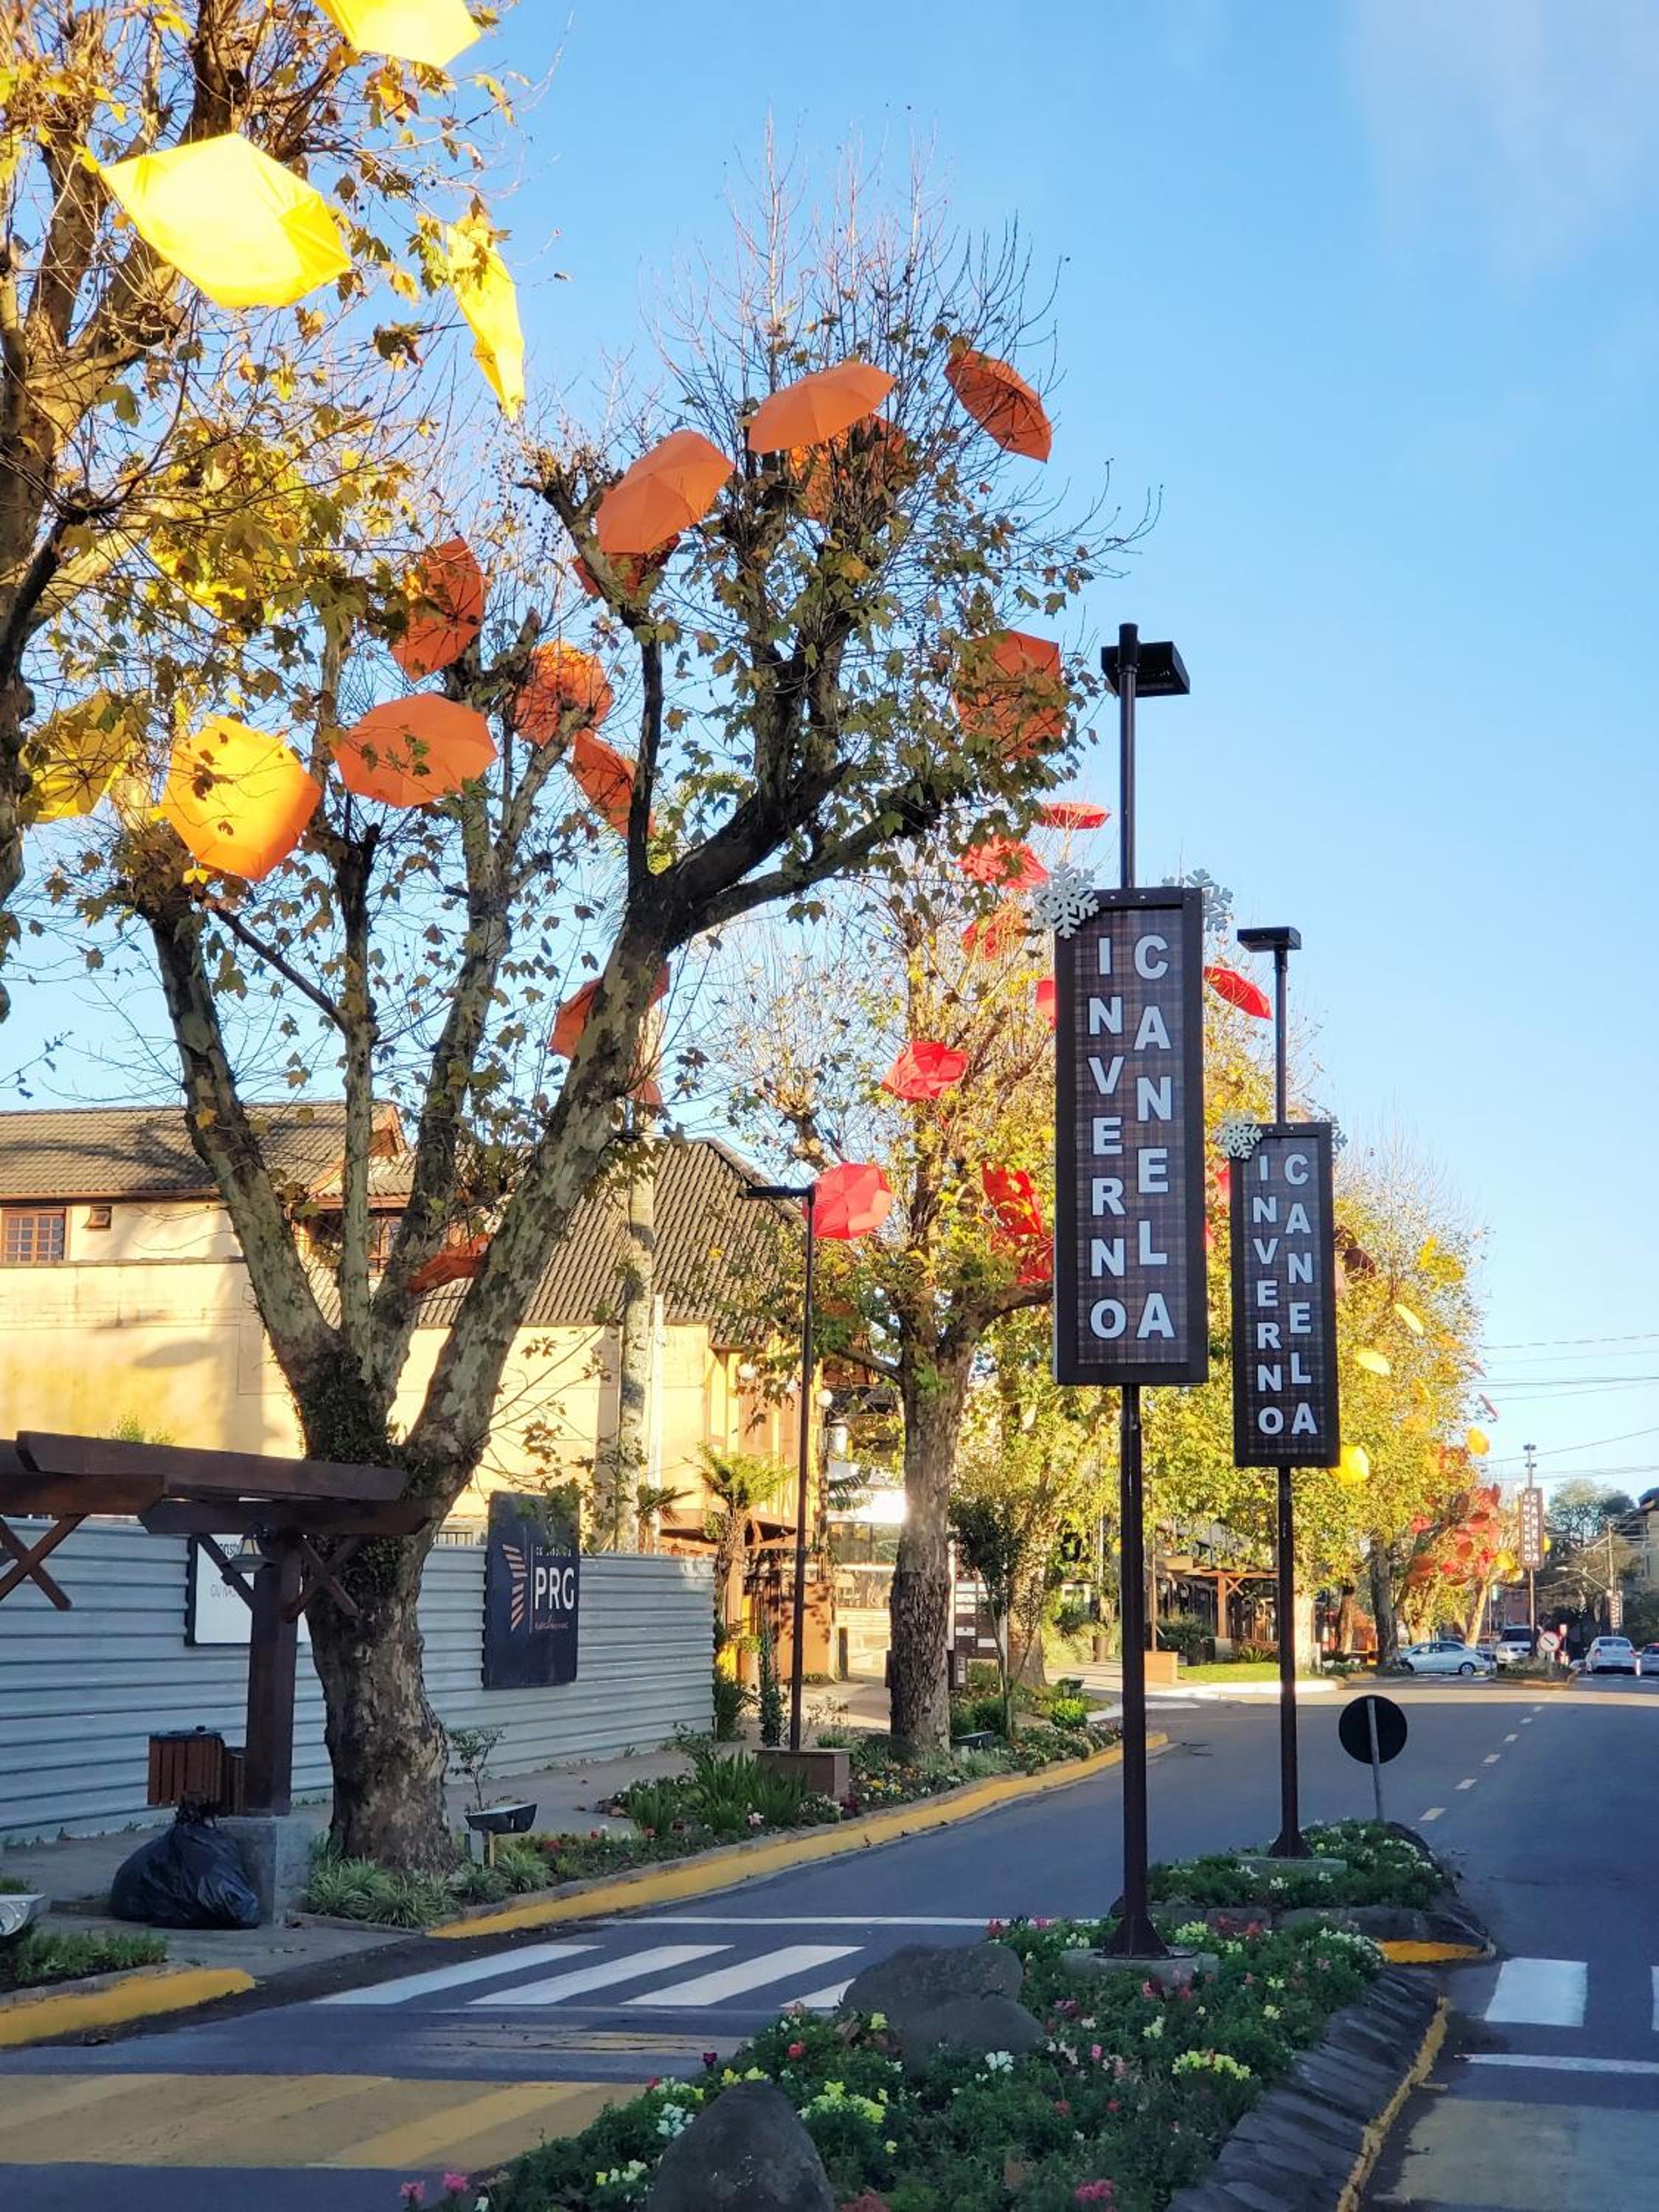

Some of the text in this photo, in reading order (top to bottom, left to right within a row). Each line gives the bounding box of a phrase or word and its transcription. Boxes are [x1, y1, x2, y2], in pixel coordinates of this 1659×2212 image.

[1088, 936, 1126, 1339] INVERNO
[1133, 934, 1175, 1339] CANELA
[1253, 1155, 1284, 1435] INVERNO
[1284, 1153, 1318, 1435] CANELA
[535, 1566, 575, 1610] PRG
